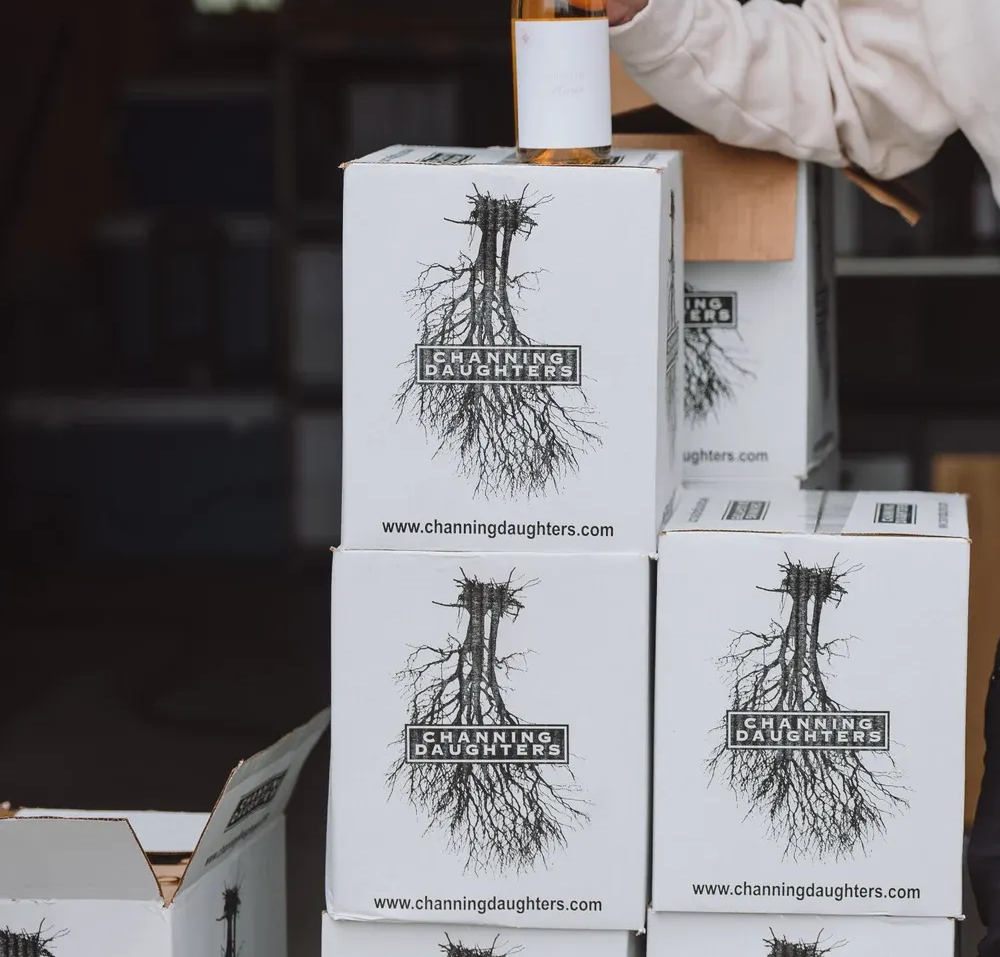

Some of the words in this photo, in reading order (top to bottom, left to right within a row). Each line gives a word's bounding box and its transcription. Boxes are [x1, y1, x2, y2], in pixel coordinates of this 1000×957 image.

[685, 309, 730, 322] ERS
[433, 352, 564, 365] CHANNING
[425, 364, 573, 377] DAUGHTERS
[382, 519, 614, 539] www.channingdaughters.com
[744, 717, 873, 730] CHANNING
[422, 731, 551, 744] CHANNING
[736, 730, 881, 743] DAUGHTERS
[415, 744, 561, 756] DAUGHTERS
[692, 881, 921, 901] www.channingdaughters.com
[374, 895, 602, 914] www.channingdaughters.com
